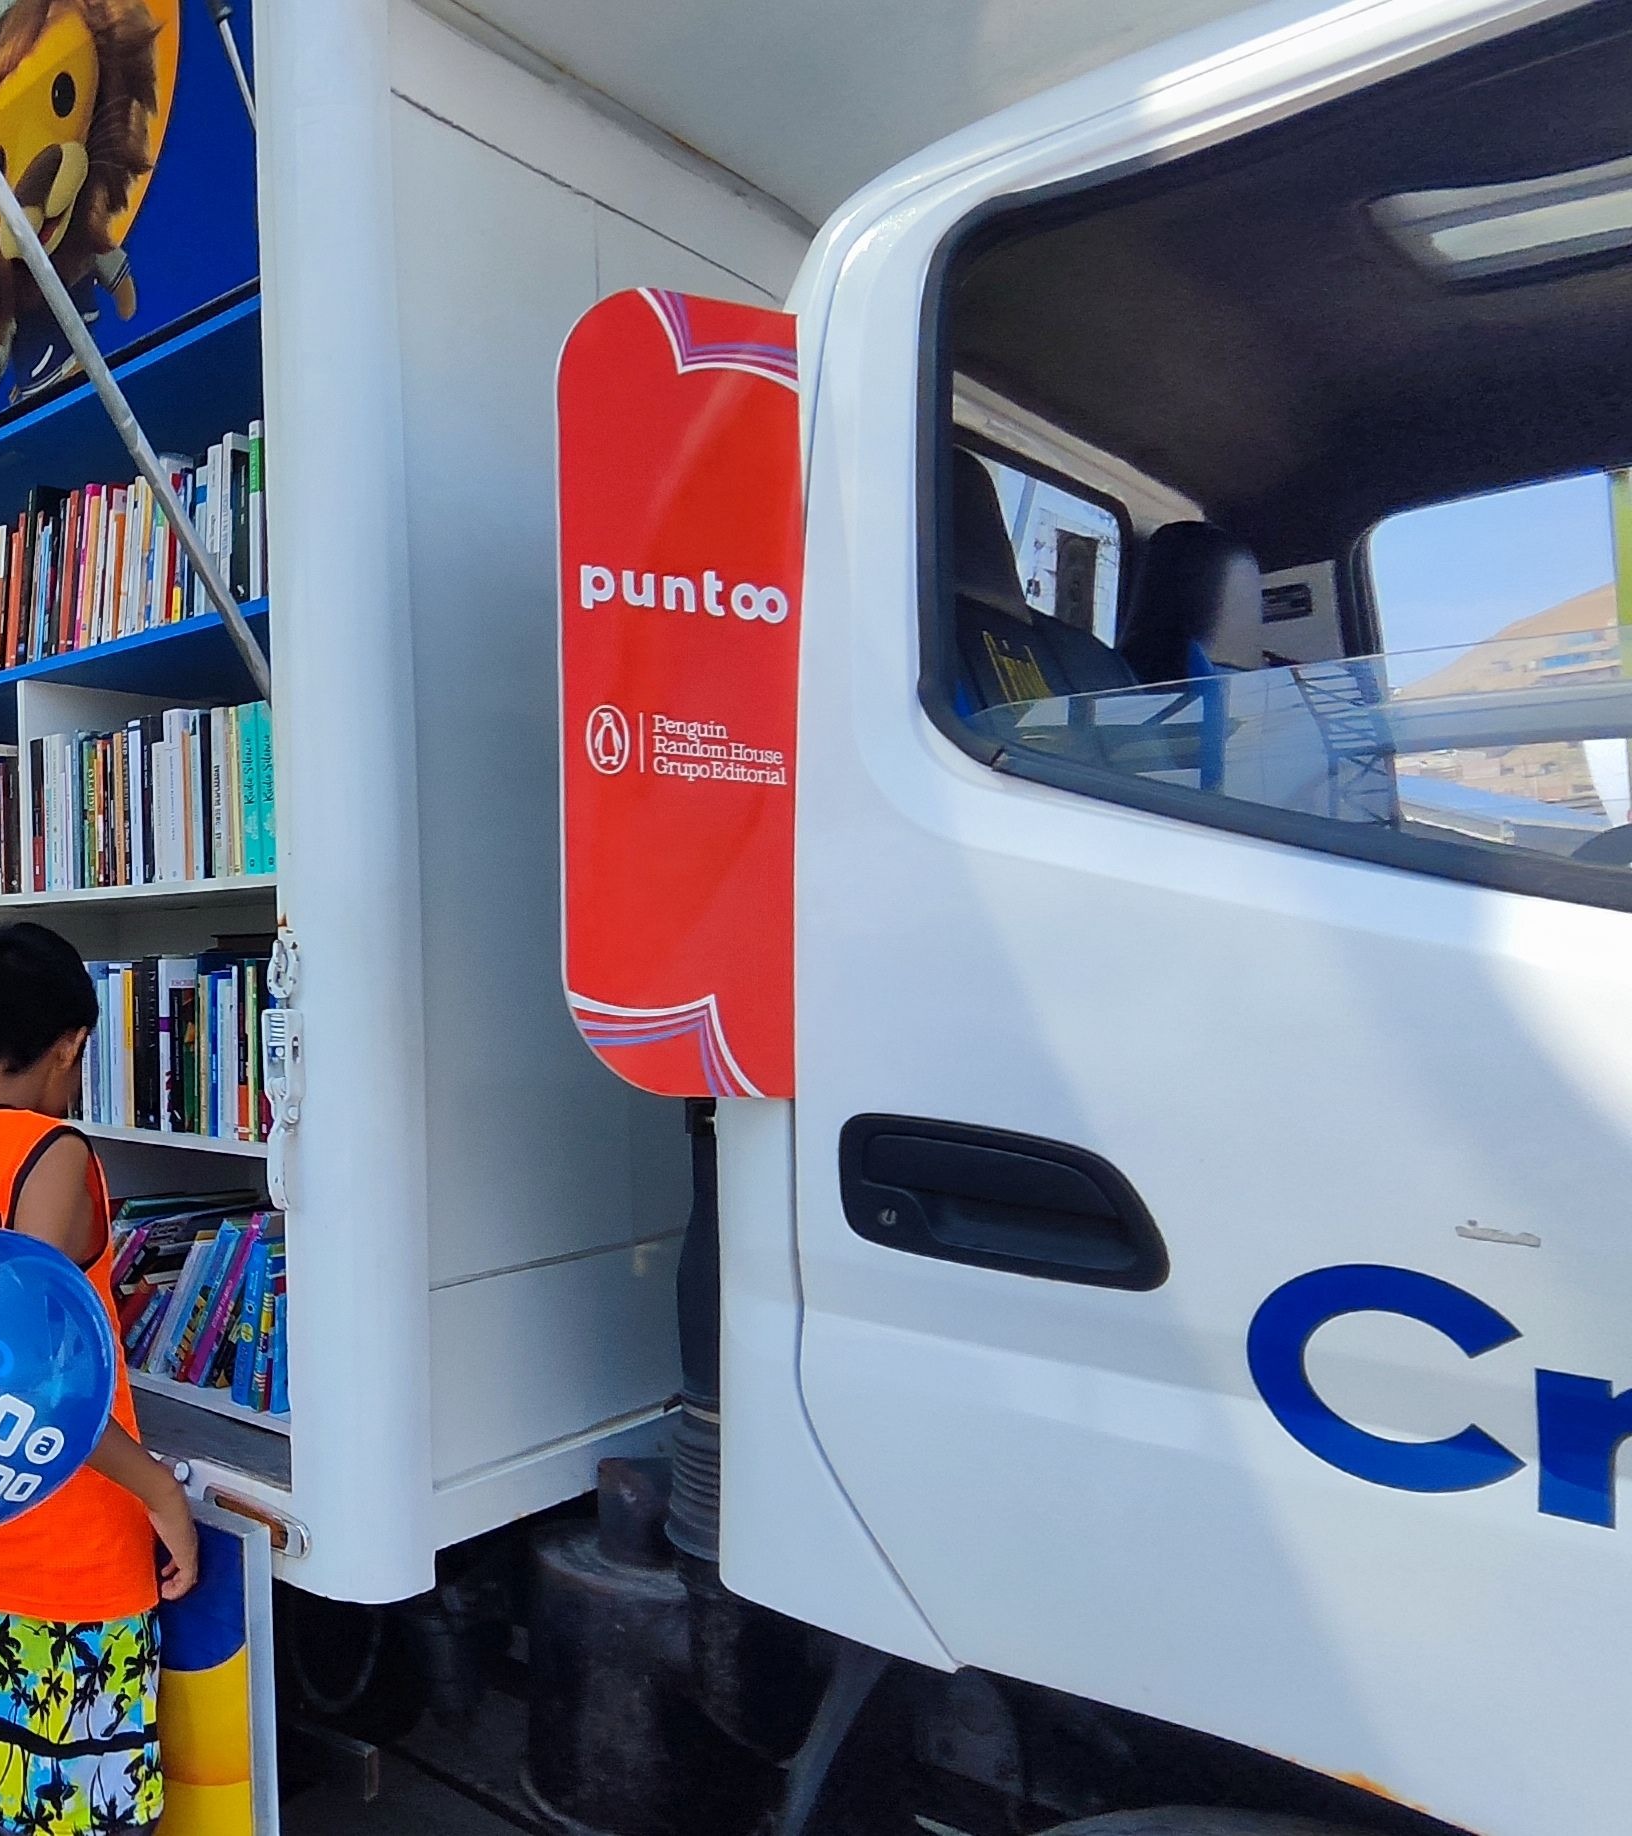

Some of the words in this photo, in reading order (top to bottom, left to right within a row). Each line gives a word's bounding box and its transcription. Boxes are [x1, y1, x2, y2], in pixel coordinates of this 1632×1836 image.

[651, 713, 729, 742] Penguin
[652, 734, 727, 759] Random
[729, 741, 784, 765] House
[652, 755, 711, 782] Grupo
[710, 760, 788, 786] Editorial
